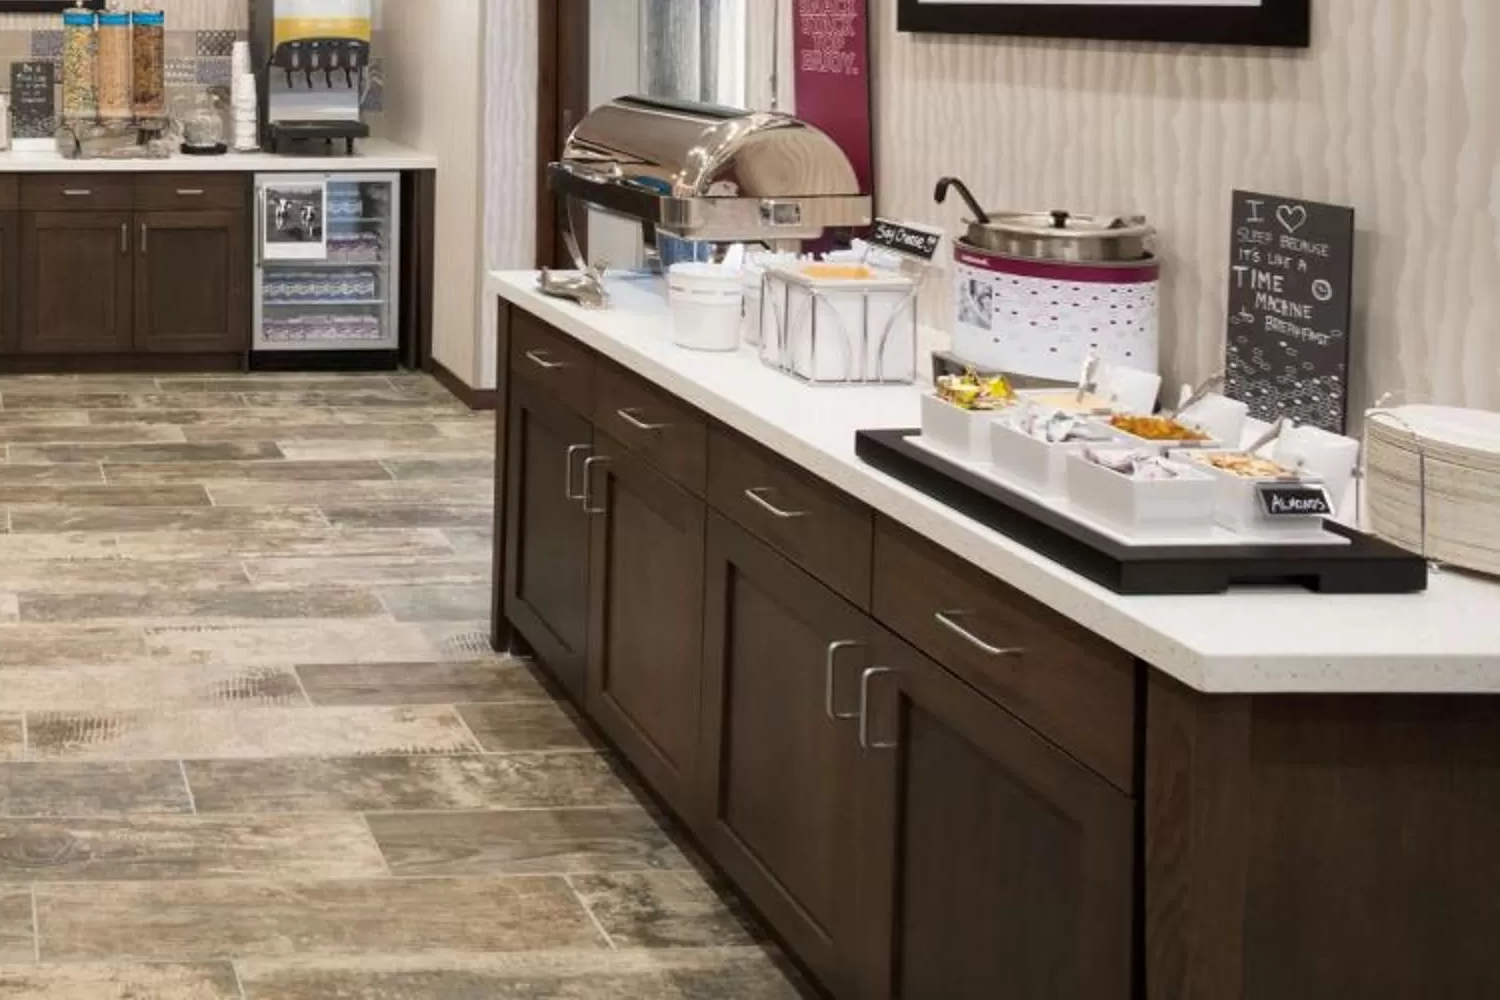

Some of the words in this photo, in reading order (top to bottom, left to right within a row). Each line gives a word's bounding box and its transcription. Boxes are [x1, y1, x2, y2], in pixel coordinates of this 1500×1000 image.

[1244, 199, 1264, 222] I
[1297, 258, 1308, 273] A
[1232, 265, 1284, 294] TIME
[1254, 291, 1314, 319] MACHINE
